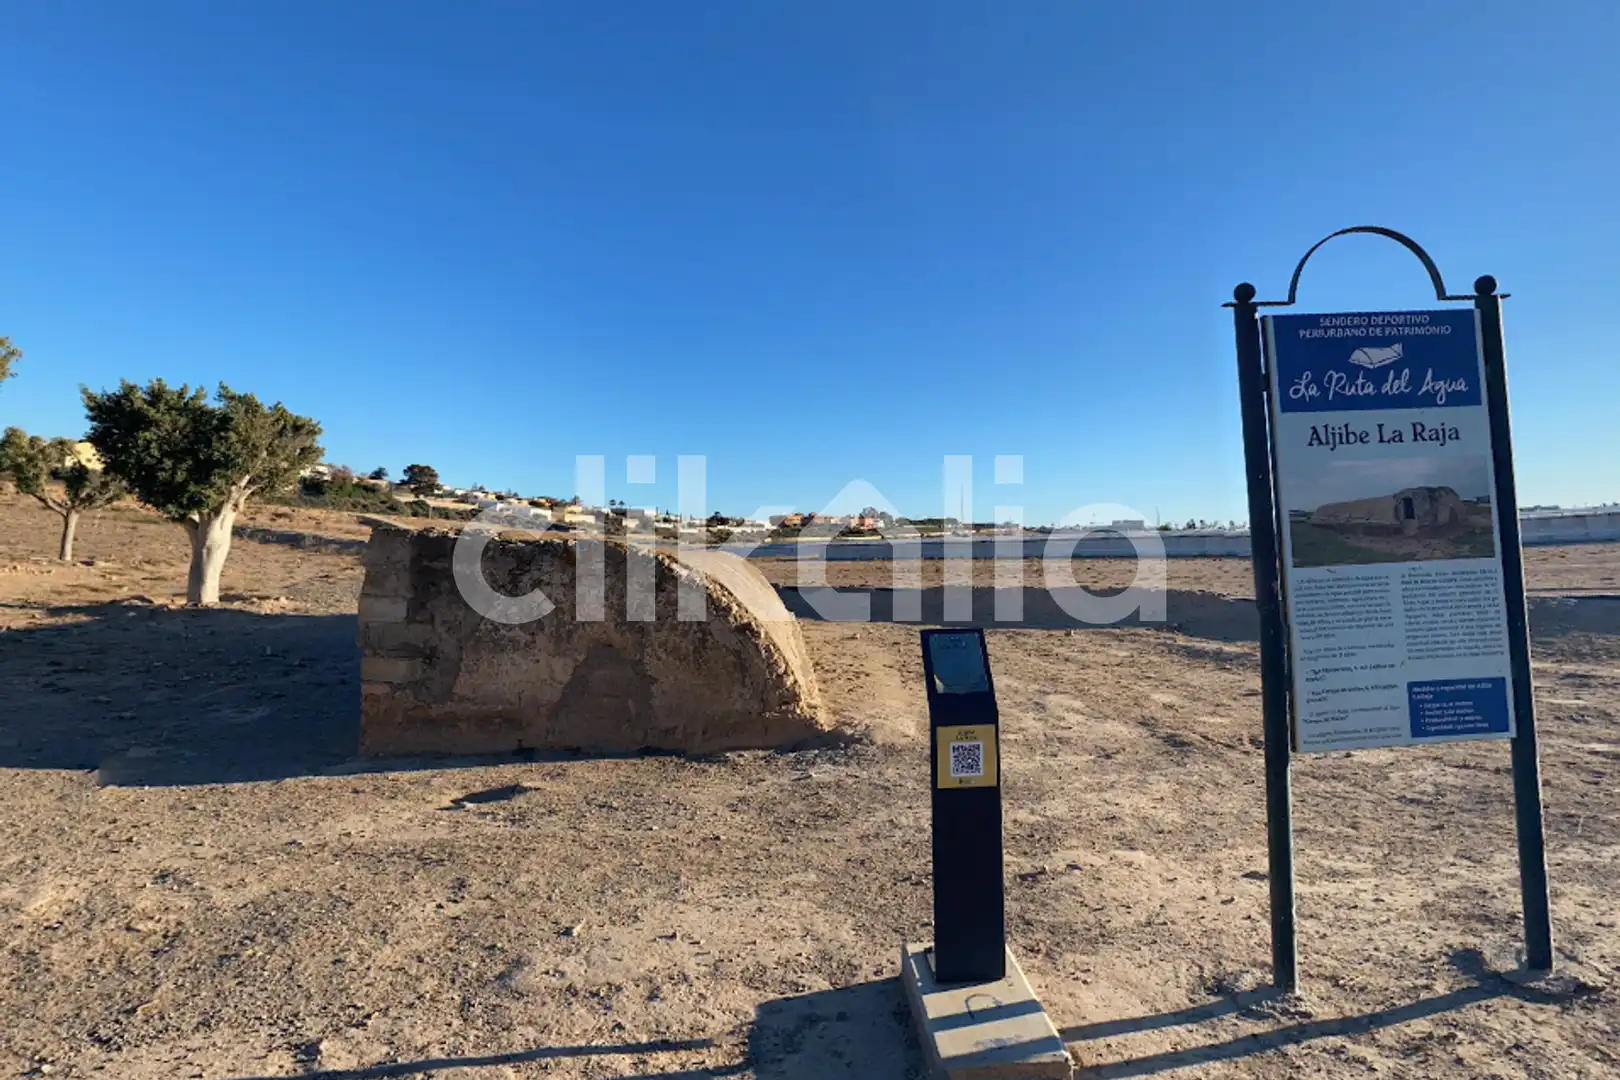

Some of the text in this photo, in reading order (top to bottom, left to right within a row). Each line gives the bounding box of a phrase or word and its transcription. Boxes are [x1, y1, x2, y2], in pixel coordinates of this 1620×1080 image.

[1319, 314, 1430, 327] SENDERO DEPORTIVO
[1368, 327, 1383, 337] DE
[1384, 325, 1451, 336] PATRIMONIO
[1289, 367, 1469, 404] La Ruta del Agua
[1307, 422, 1461, 451] Aljibe La Raja
